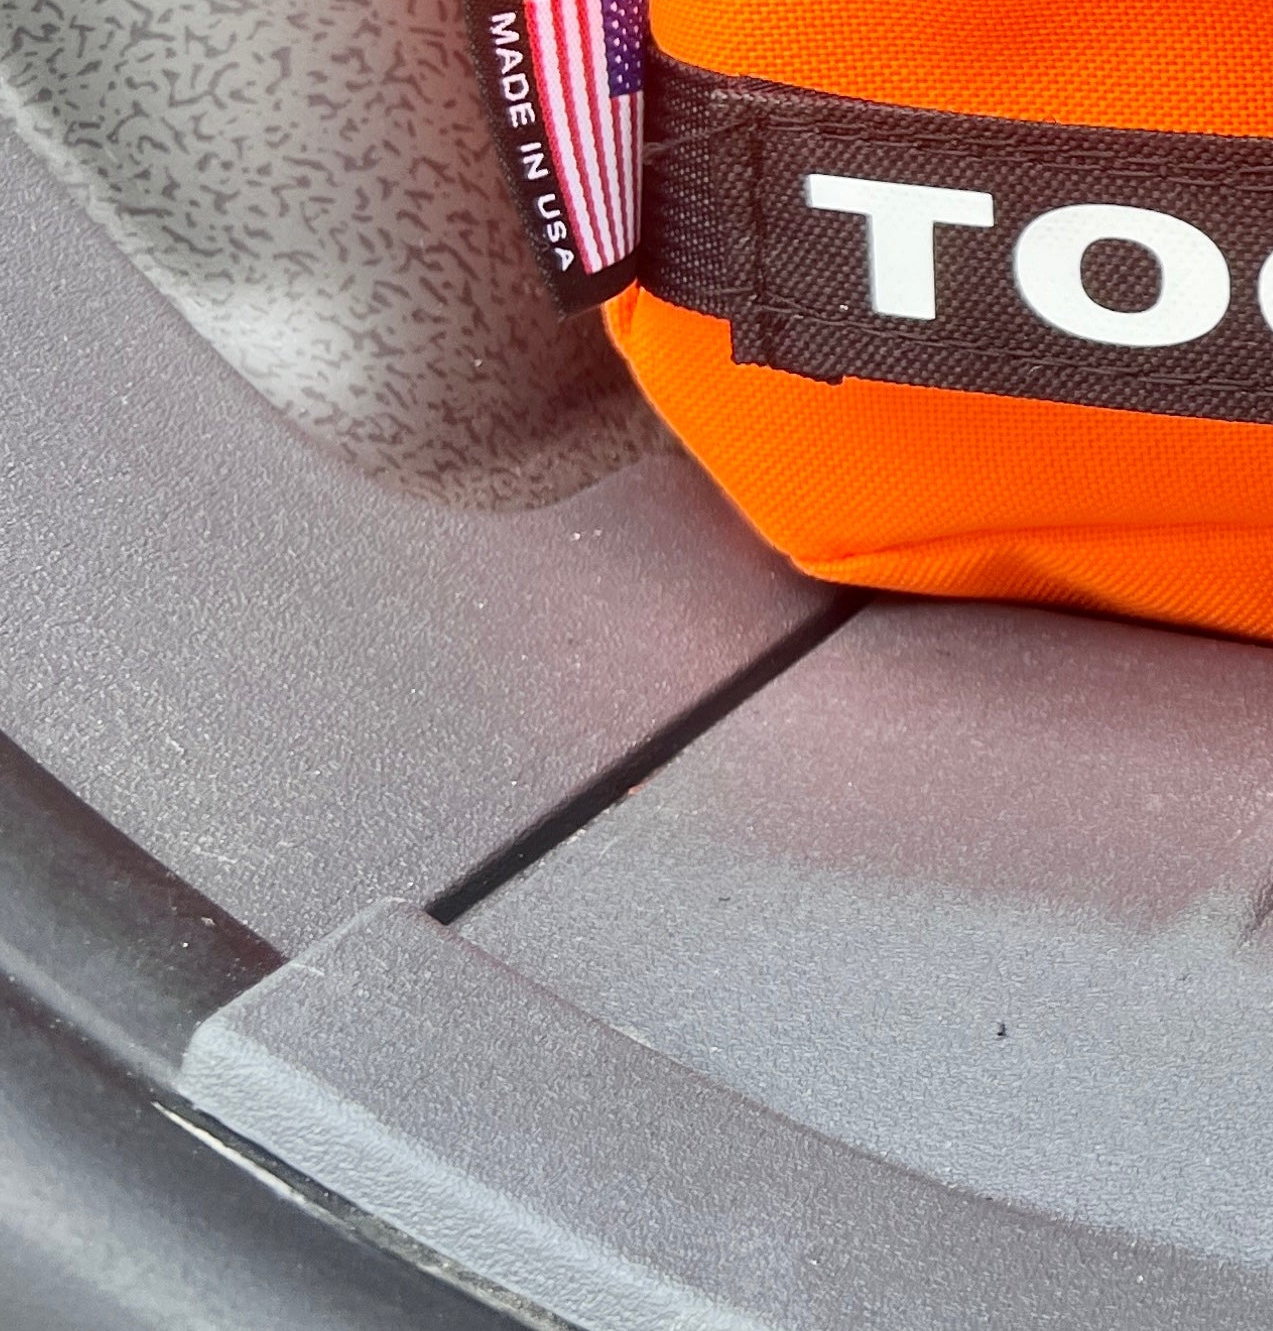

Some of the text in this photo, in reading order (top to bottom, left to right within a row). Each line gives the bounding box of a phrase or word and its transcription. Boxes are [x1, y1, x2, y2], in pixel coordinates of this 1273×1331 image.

[489, 11, 575, 272] MADE IN USA
